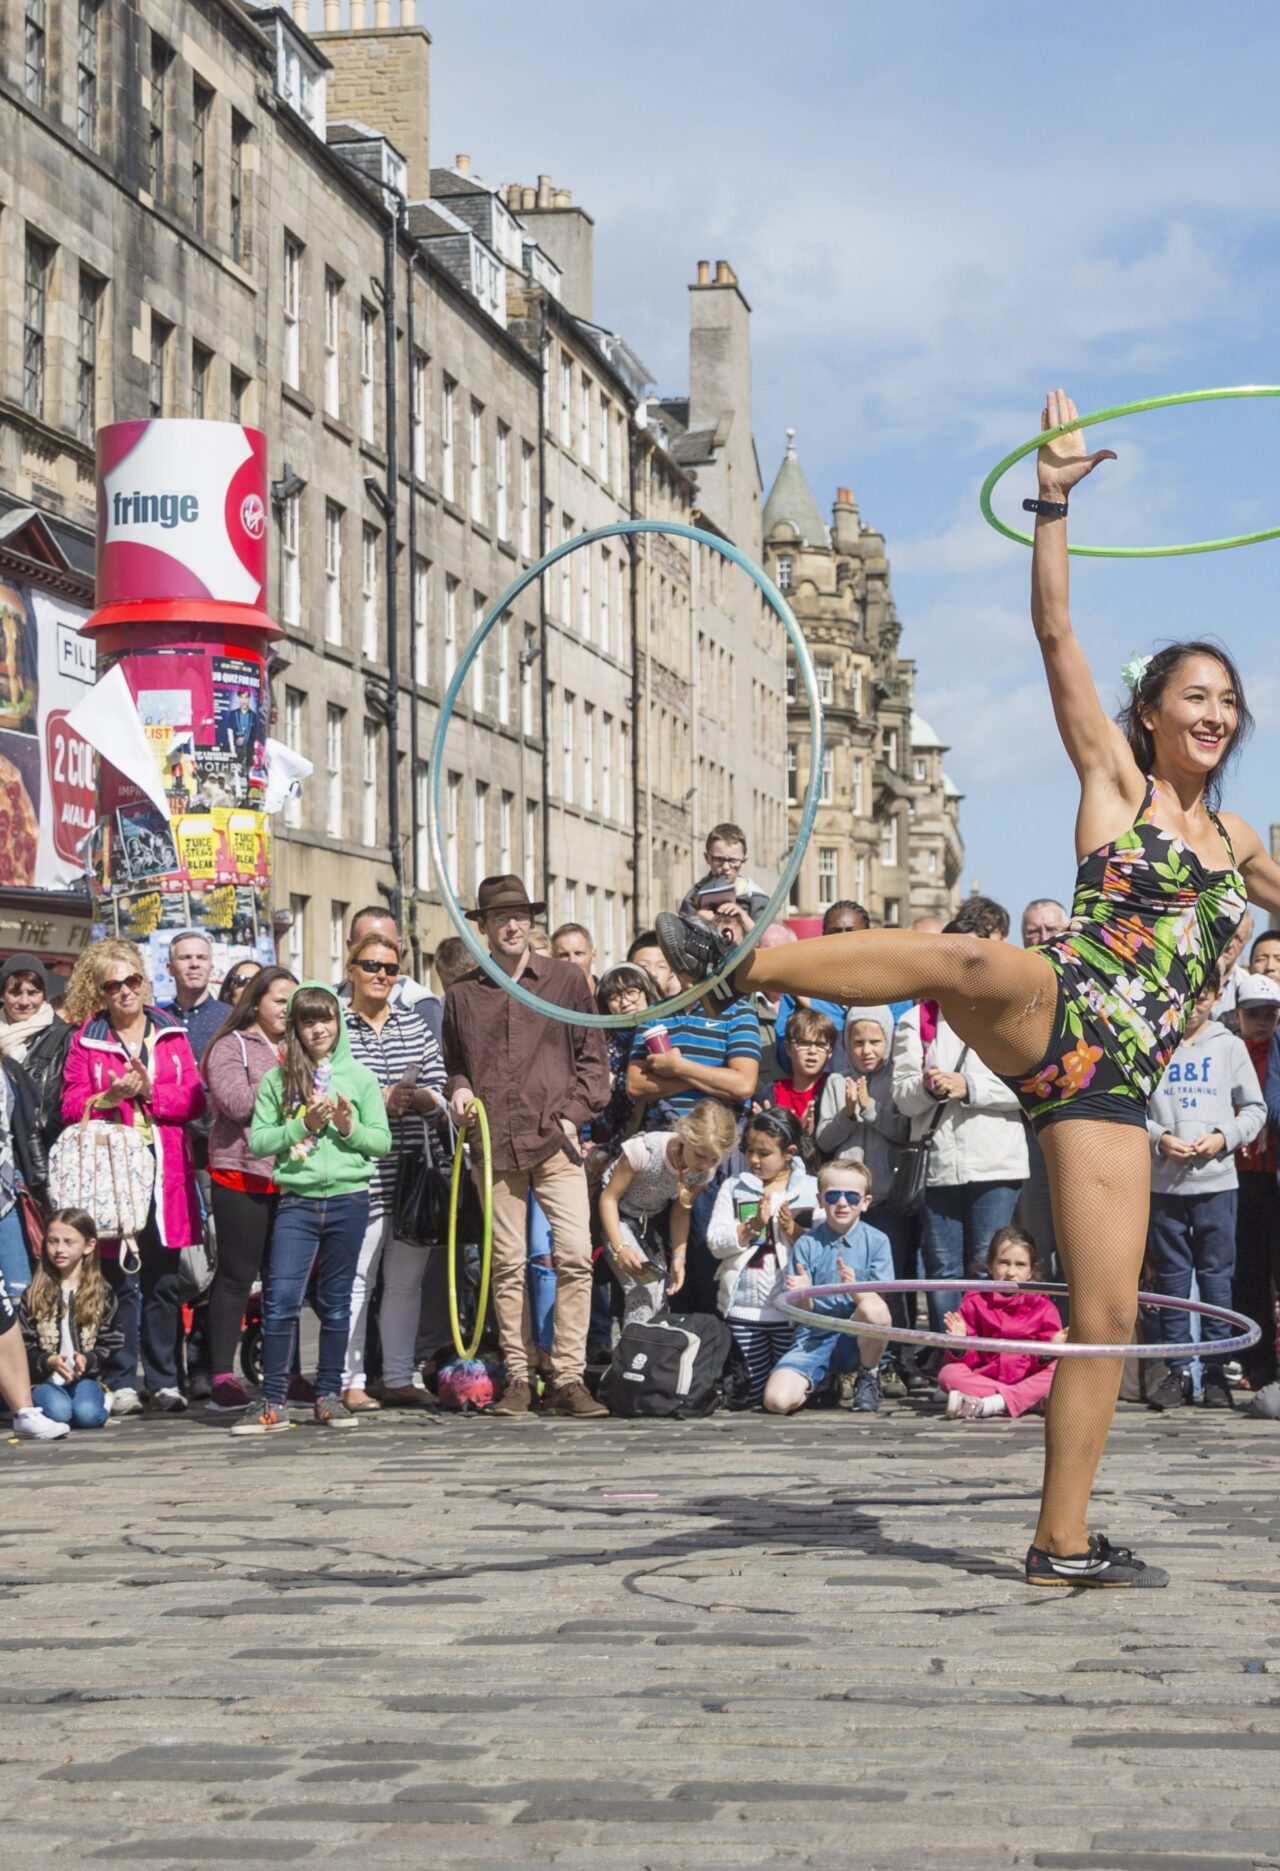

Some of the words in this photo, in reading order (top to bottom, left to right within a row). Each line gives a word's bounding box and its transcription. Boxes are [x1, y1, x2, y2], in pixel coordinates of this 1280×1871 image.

[113, 491, 199, 528] fringe
[54, 734, 65, 782] 2
[19, 919, 55, 946] THE
[1168, 1056, 1212, 1083] a&f
[1178, 1086, 1217, 1096] TRAINING
